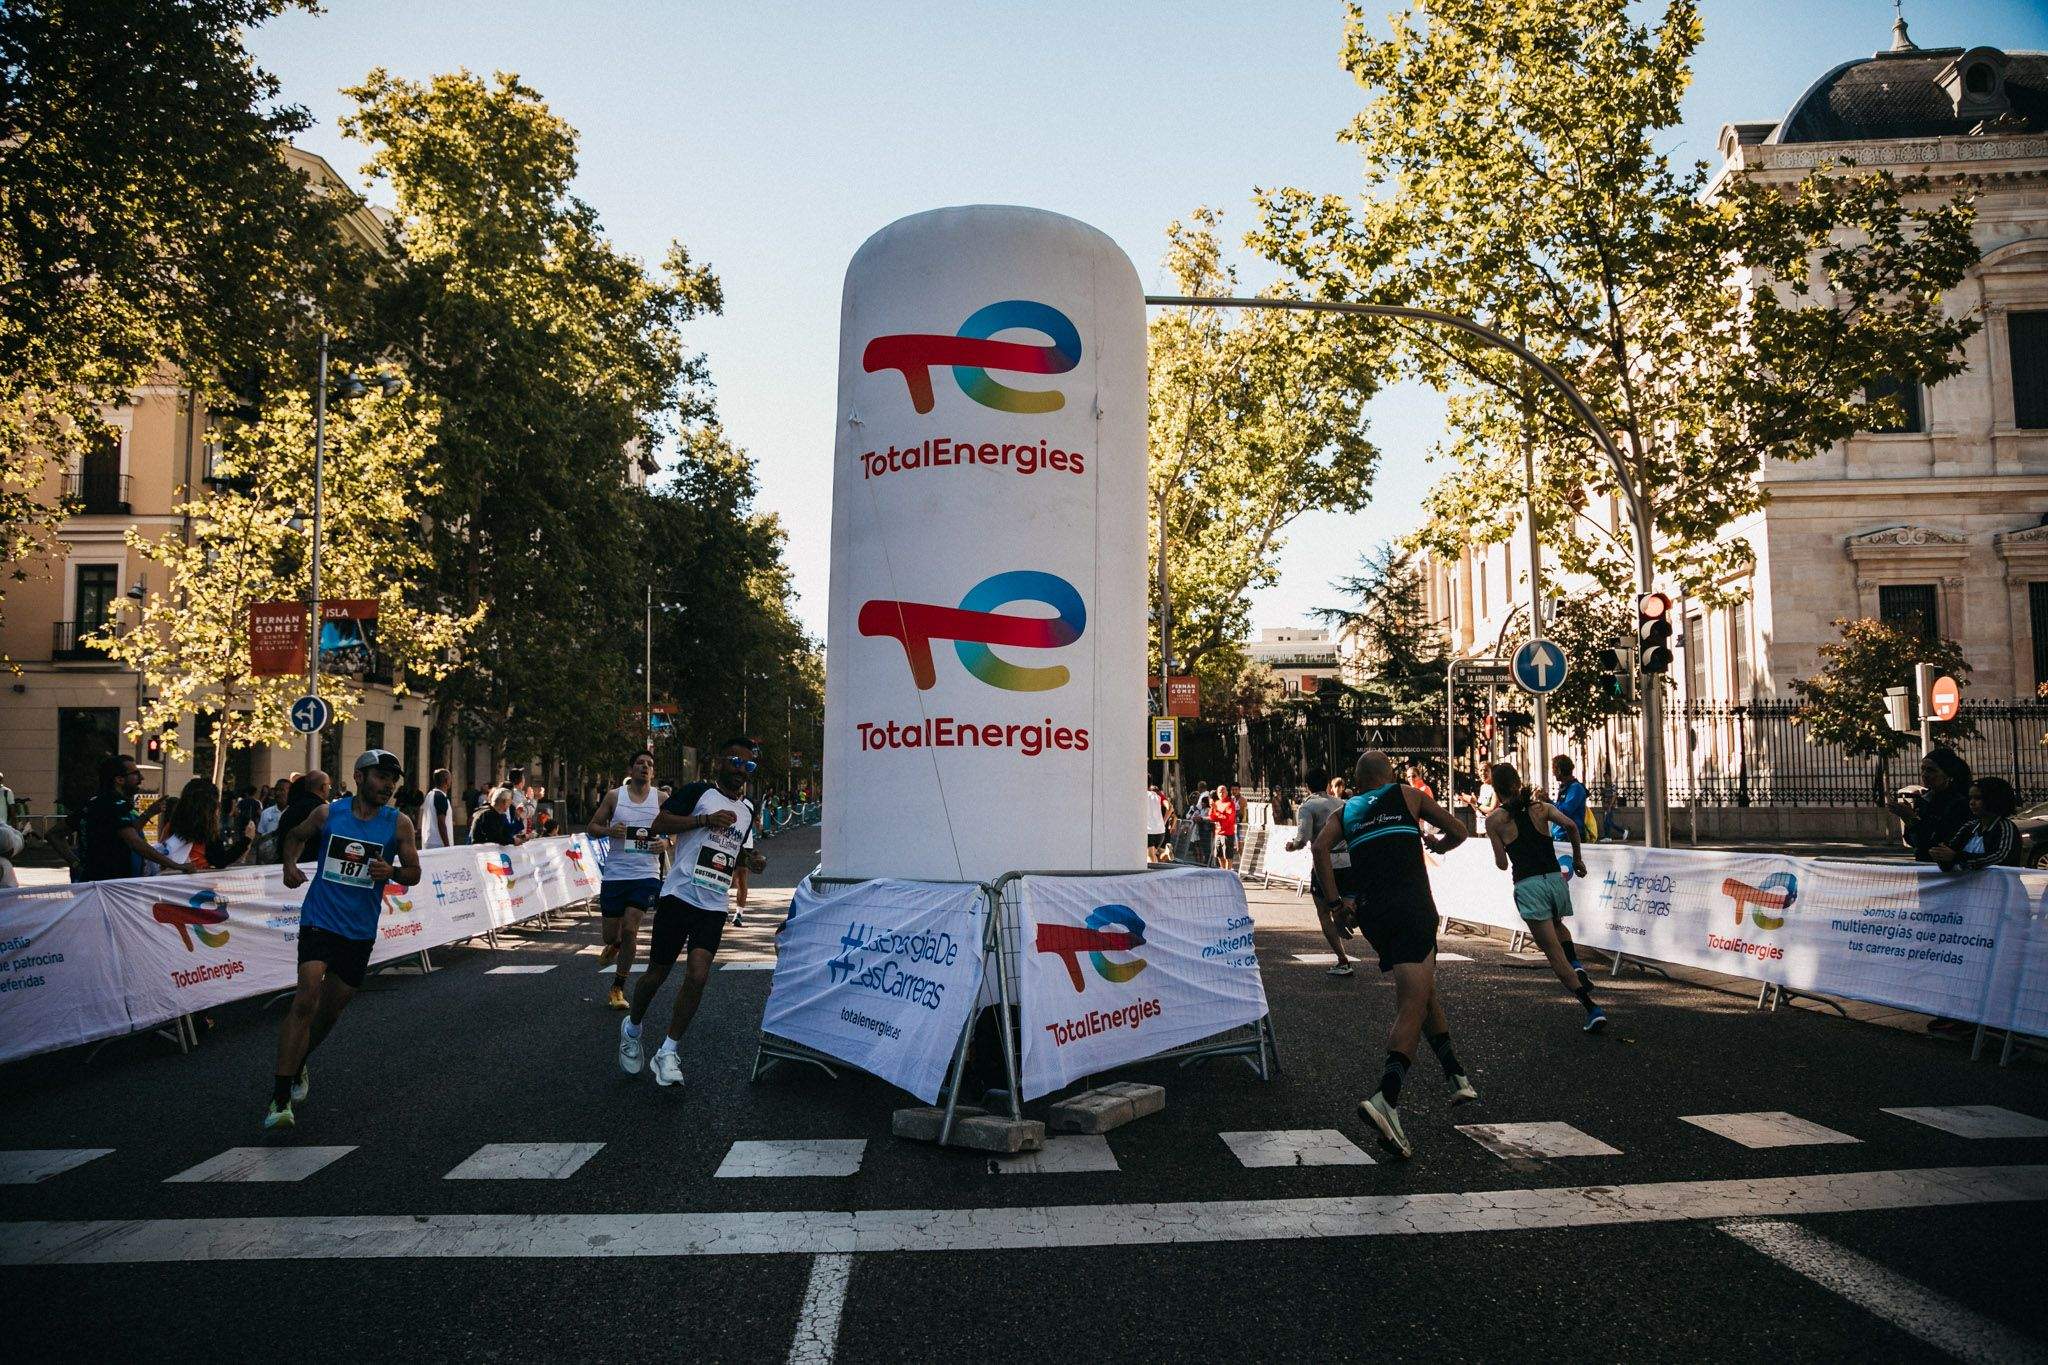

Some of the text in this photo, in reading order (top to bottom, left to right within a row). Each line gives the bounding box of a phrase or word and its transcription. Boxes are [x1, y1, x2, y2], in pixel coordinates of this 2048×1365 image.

[860, 438, 1085, 480] TotalEnergies
[255, 614, 300, 624] FERNÁN
[325, 608, 348, 618] ISLA
[857, 718, 1089, 757] TotalEnergies
[634, 841, 648, 850] 195
[340, 861, 363, 877] 187
[1862, 906, 1895, 919] Somos
[1898, 908, 1907, 920] la
[1708, 934, 1784, 961] TotalEnergies
[1916, 930, 1937, 943] que
[1939, 933, 1995, 949] patrocina
[13, 952, 65, 972] patrocina
[1848, 940, 1964, 966] tus carreras preferidas
[171, 958, 245, 988] TotalEnergies
[1045, 997, 1162, 1047] TotalEnergies
